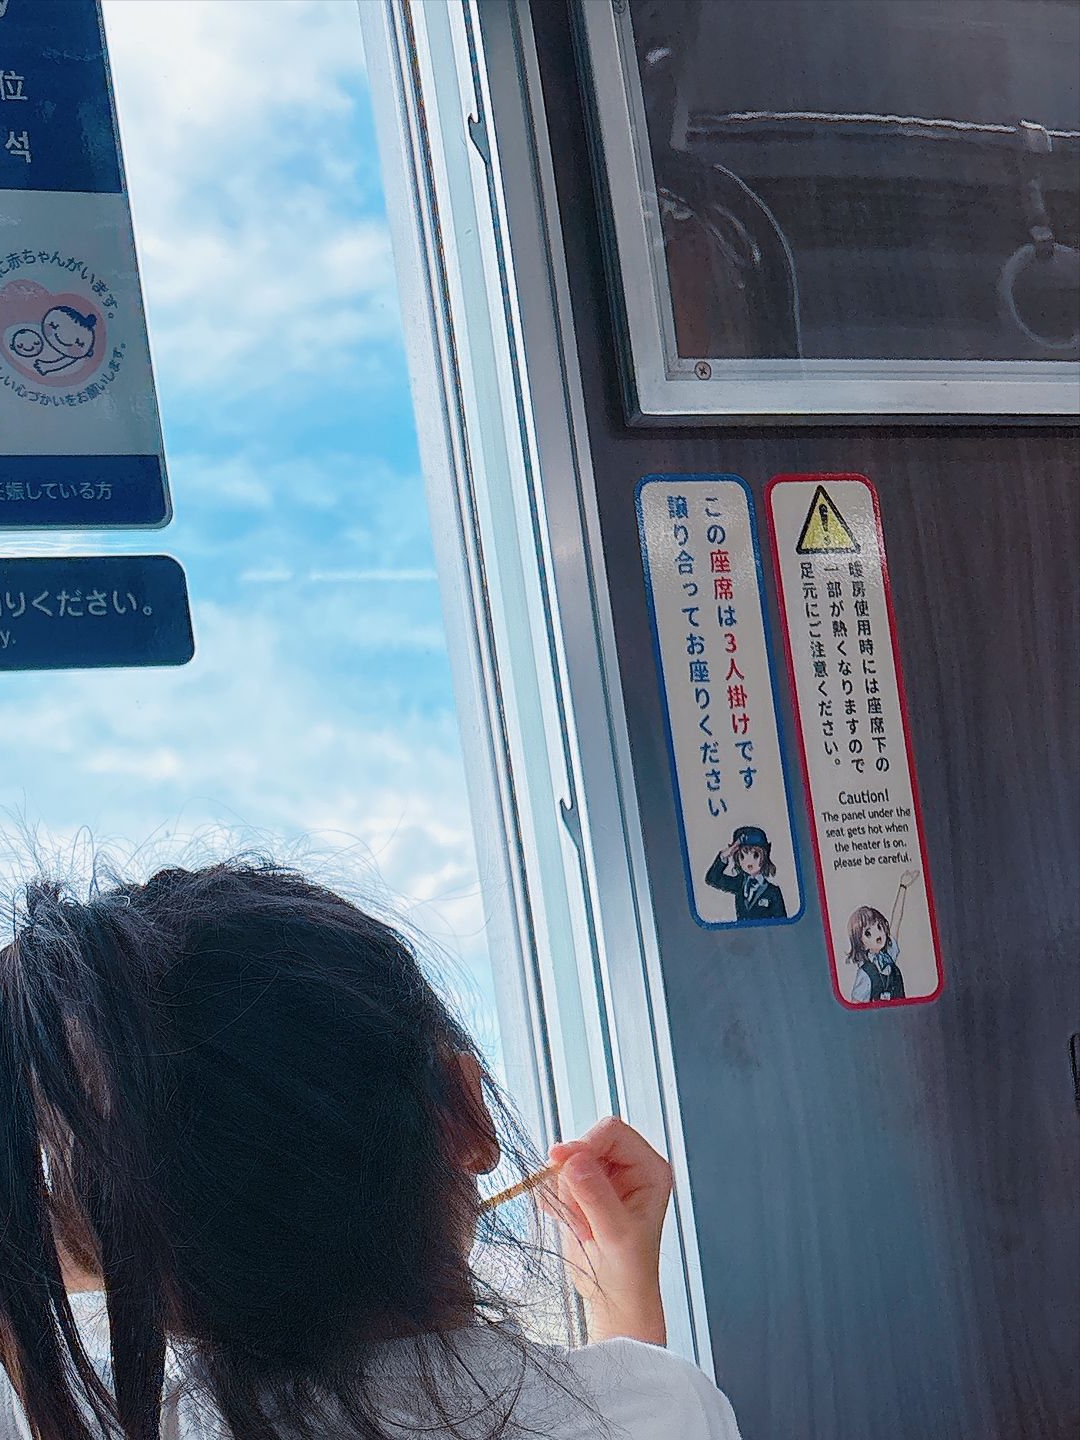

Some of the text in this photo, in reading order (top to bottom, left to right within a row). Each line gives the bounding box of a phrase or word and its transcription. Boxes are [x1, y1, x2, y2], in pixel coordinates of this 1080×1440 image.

[667, 494, 728, 818] 譲り合ってお座りください
[704, 496, 757, 789] この座席は3人掛けです
[800, 562, 841, 766] 足元にご注意ください。
[824, 567, 865, 774] 一部が熱くなりますので
[848, 562, 890, 773] 暖房使用時には座席下の
[821, 806, 911, 823] The panel under the
[825, 822, 909, 838] seat gets hot when
[834, 842, 850, 853] the
[851, 840, 880, 851] heater
[883, 838, 891, 849] is
[838, 788, 890, 805] Caution!
[834, 857, 862, 871] please
[864, 855, 876, 866] be
